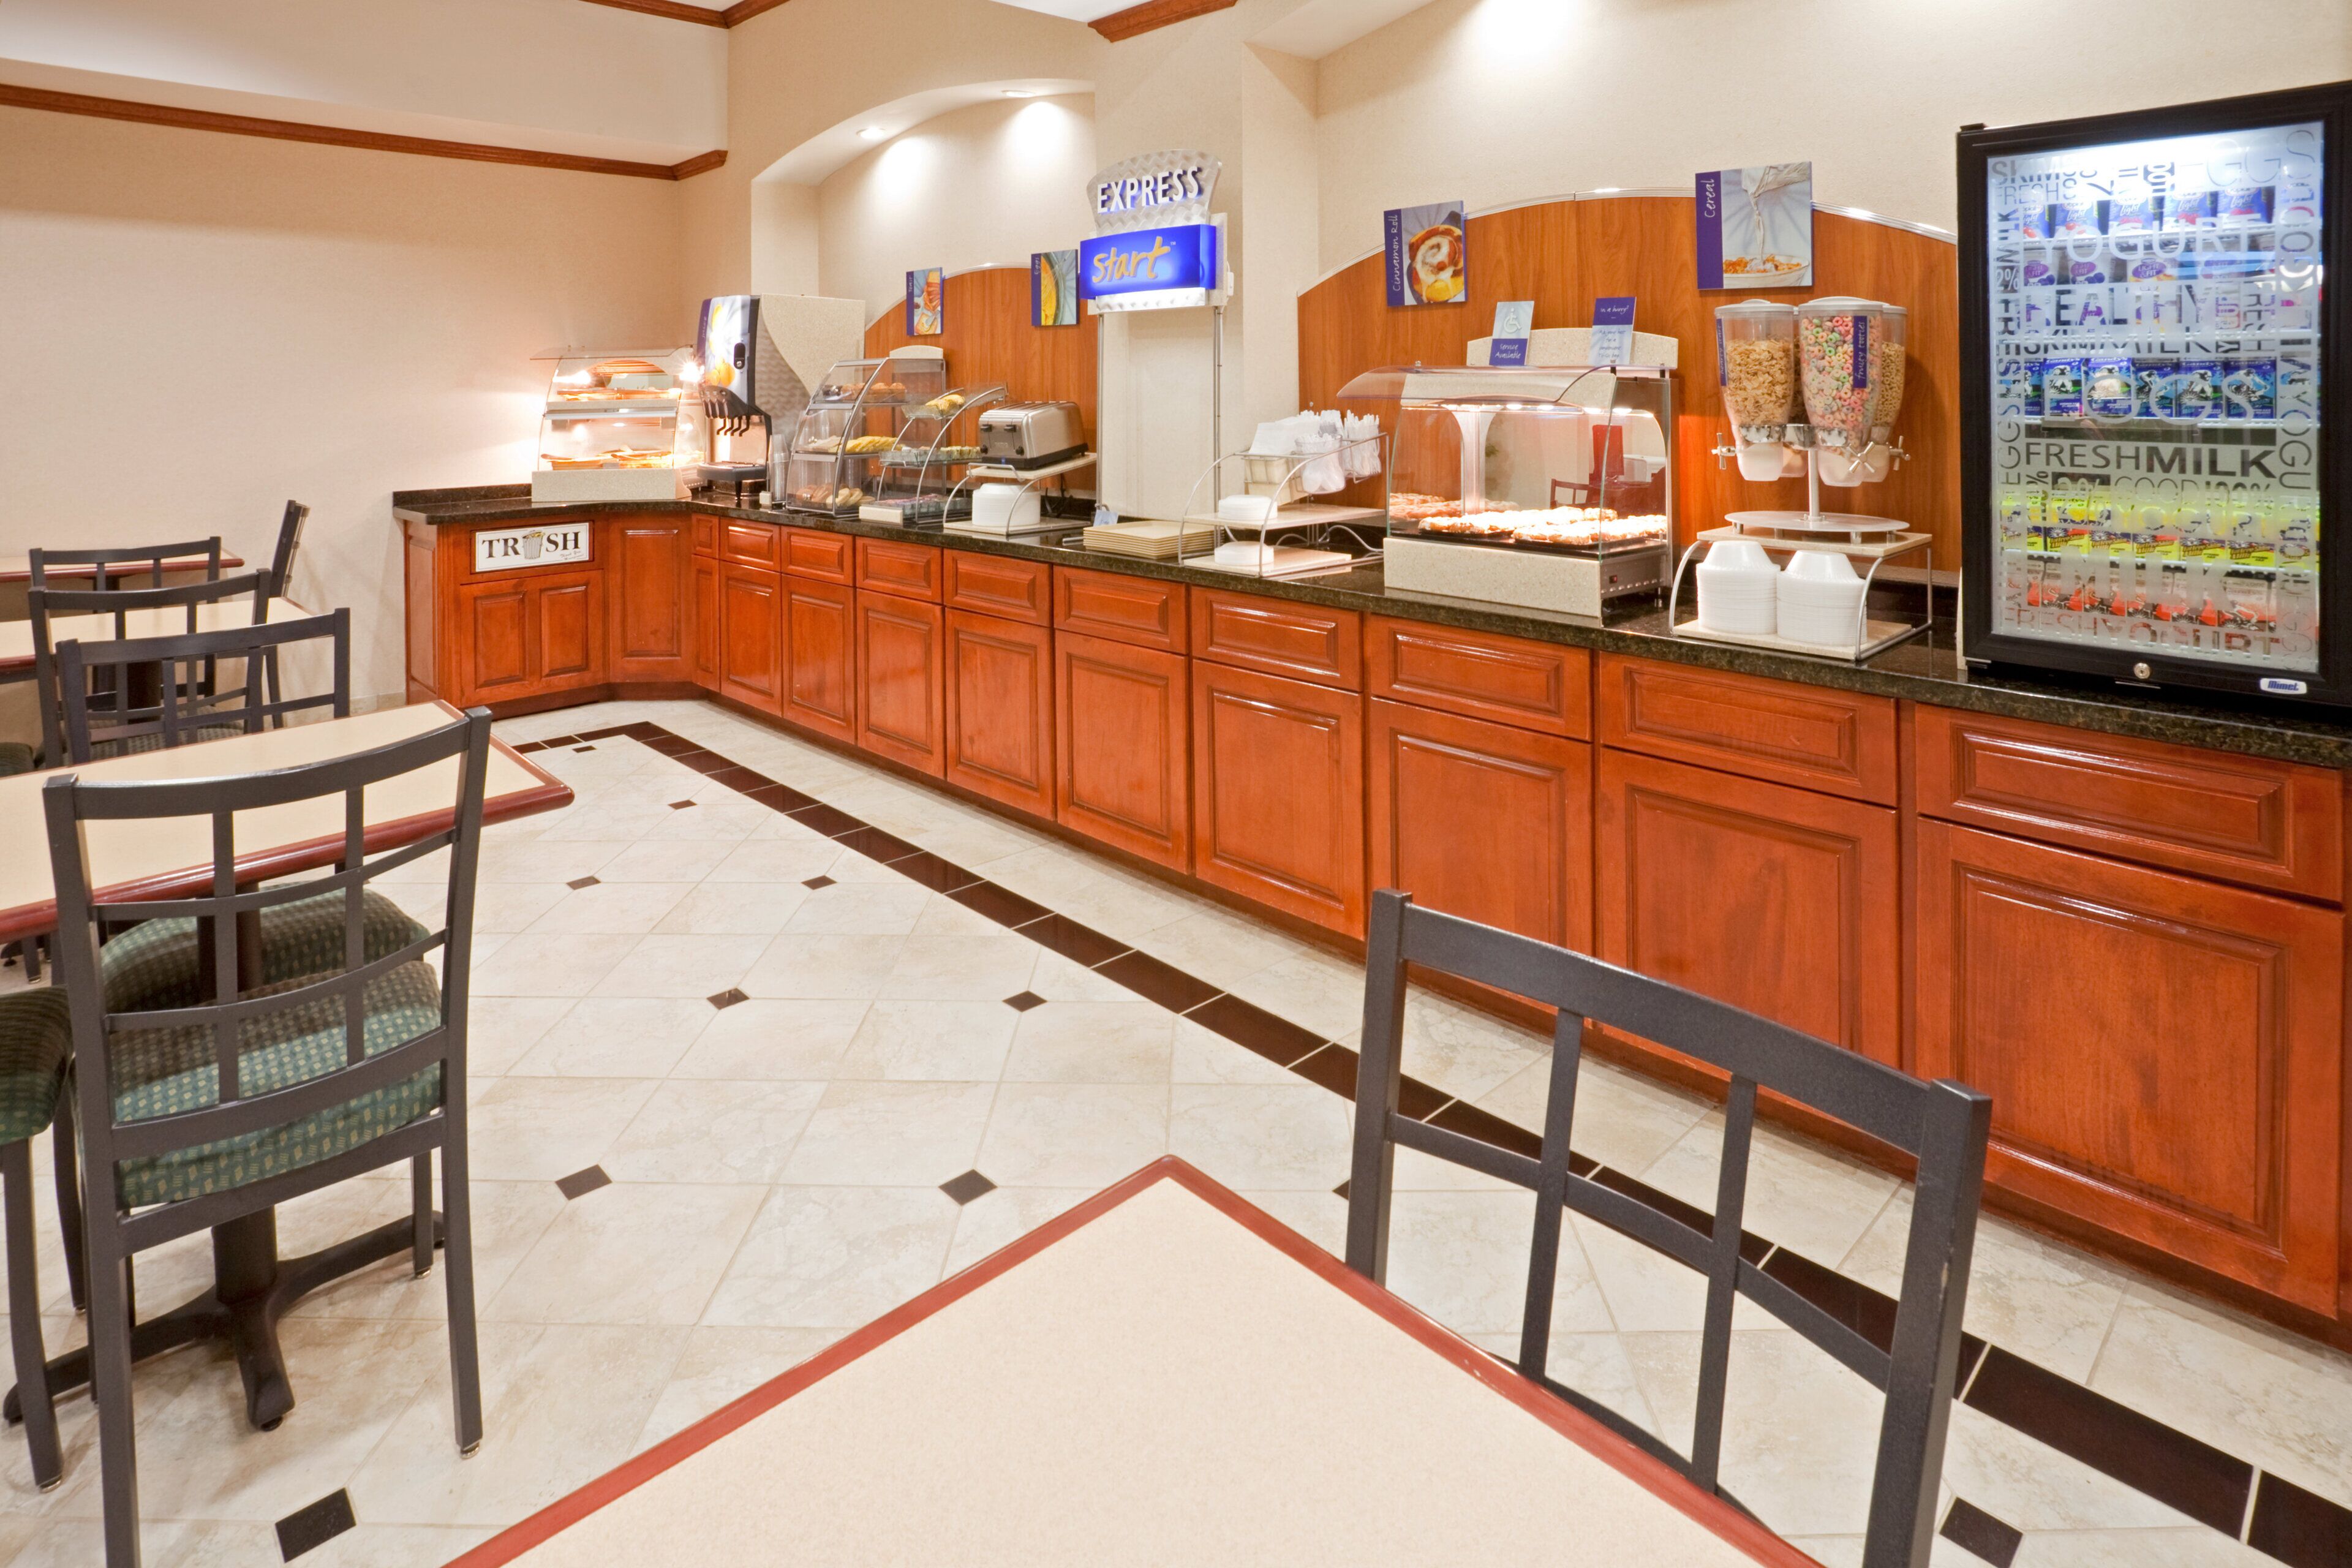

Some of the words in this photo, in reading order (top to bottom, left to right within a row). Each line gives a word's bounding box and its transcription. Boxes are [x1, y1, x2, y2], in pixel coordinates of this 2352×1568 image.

[1097, 166, 1202, 214] EXPRESS
[1700, 178, 1716, 218] Cereal
[1388, 215, 1398, 233] Roll
[2035, 212, 2261, 263] YOGURT
[1092, 236, 1171, 284] start
[1392, 236, 1401, 291] Cinnamon
[1995, 268, 2020, 290] 2%
[2026, 284, 2212, 327] HEALTHY
[2043, 374, 2255, 425] EGGS
[1997, 404, 2021, 485] EGGS
[481, 530, 581, 559] TRSH
